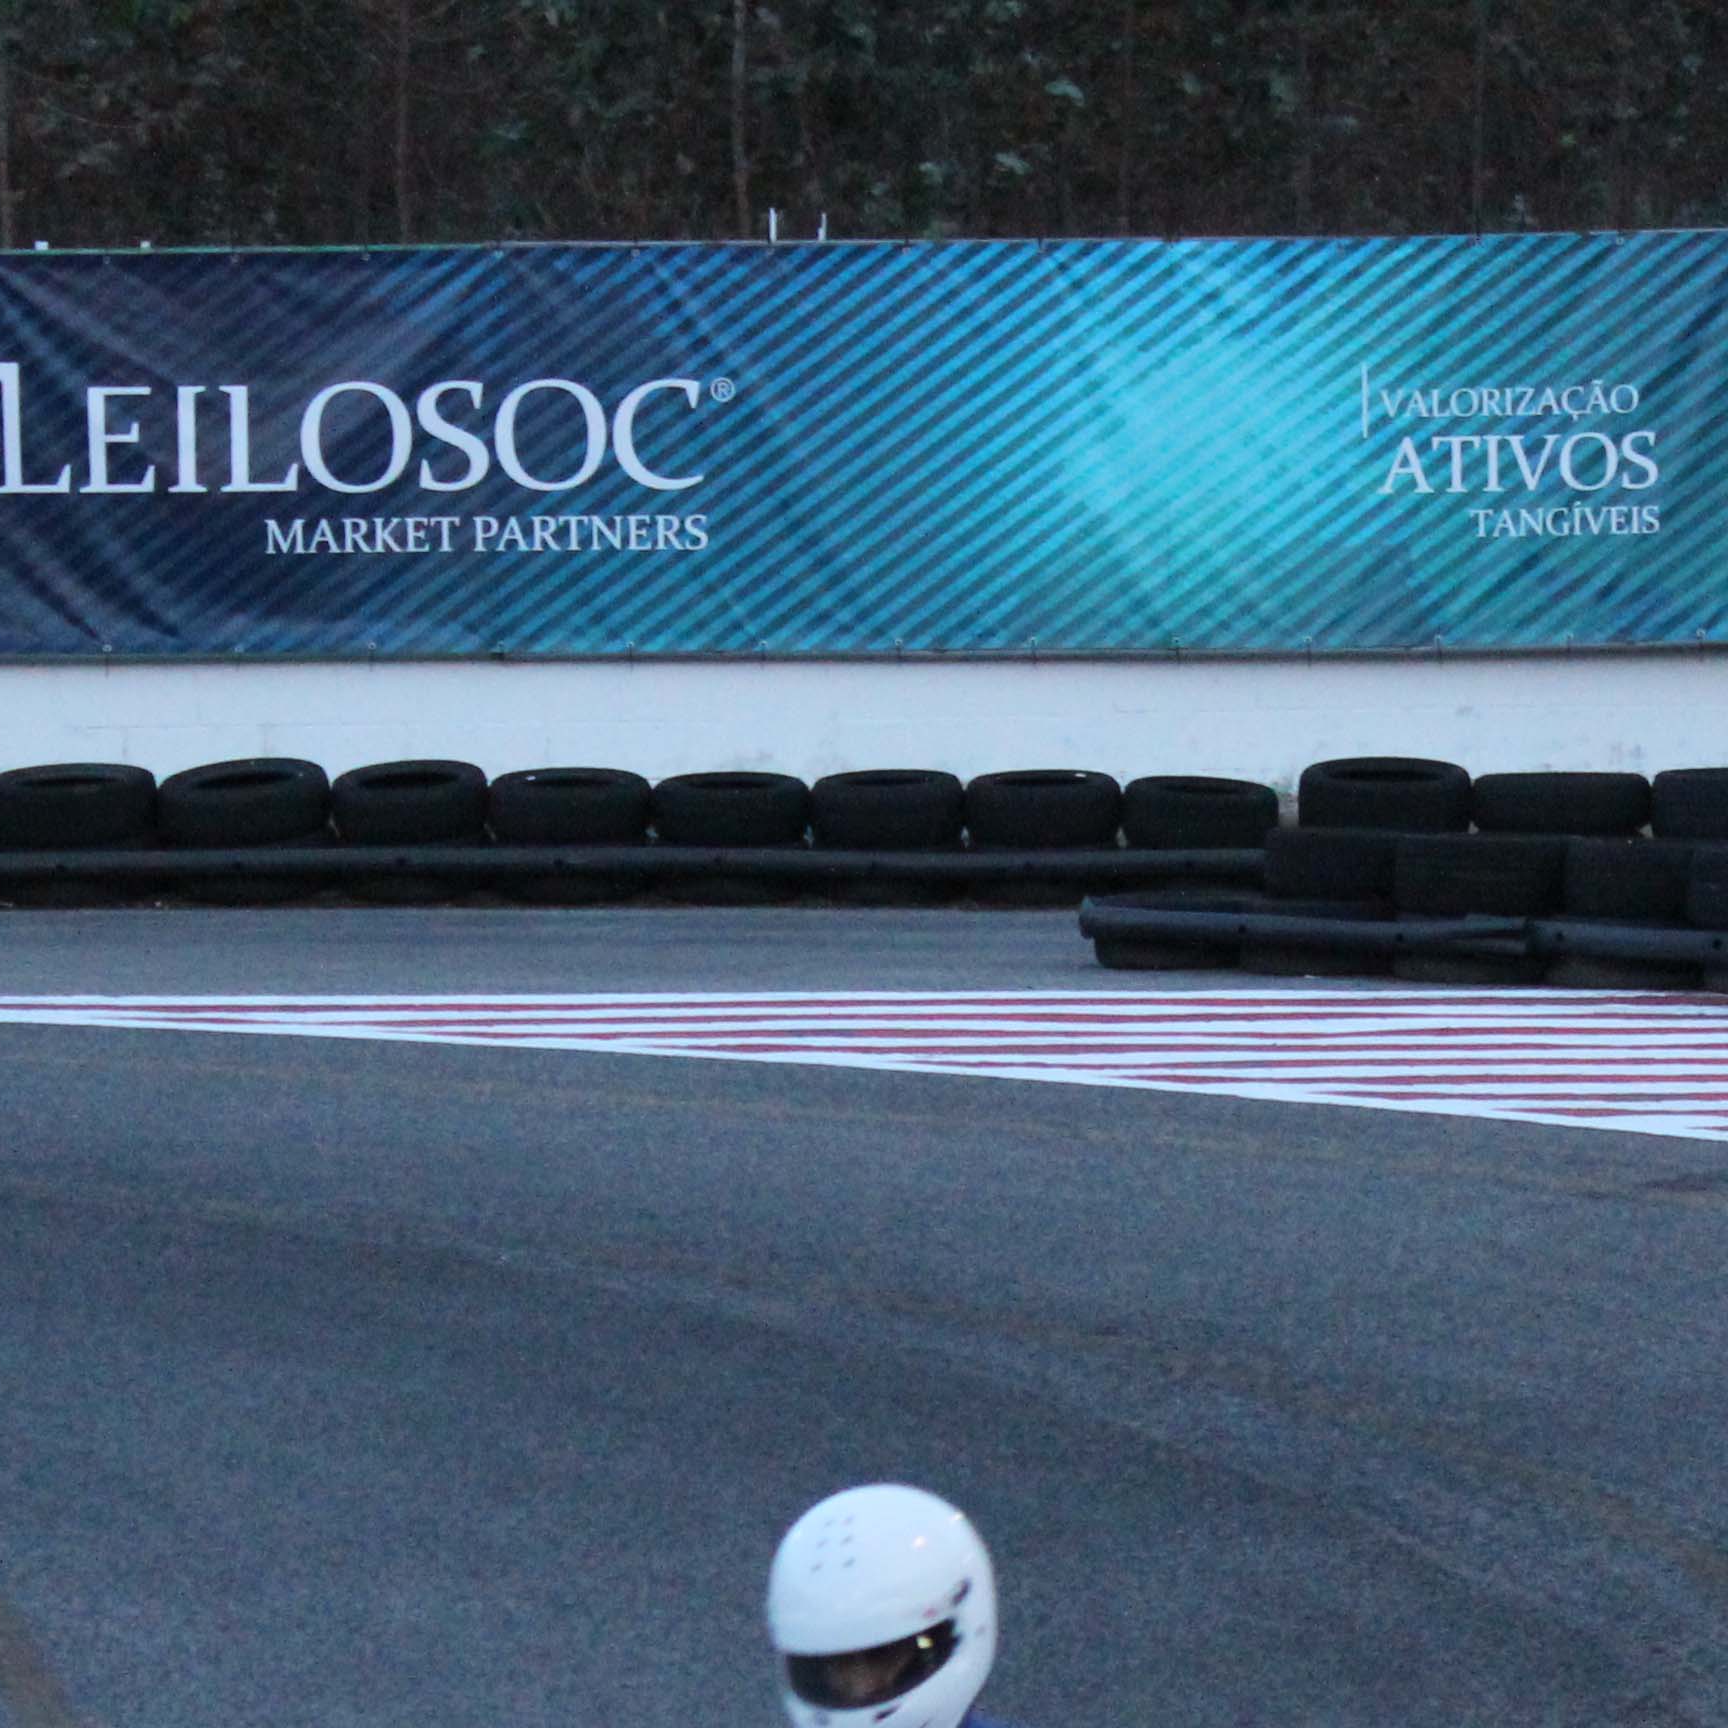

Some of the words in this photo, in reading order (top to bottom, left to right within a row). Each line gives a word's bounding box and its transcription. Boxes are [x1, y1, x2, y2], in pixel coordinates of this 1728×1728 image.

[1380, 380, 1640, 421] VALORIZAÇÃO
[1377, 430, 1660, 494] ATIVOS
[264, 516, 460, 555] MARKET
[472, 513, 709, 553] PARTNERS
[1470, 501, 1661, 537] TANGÍVEIS
